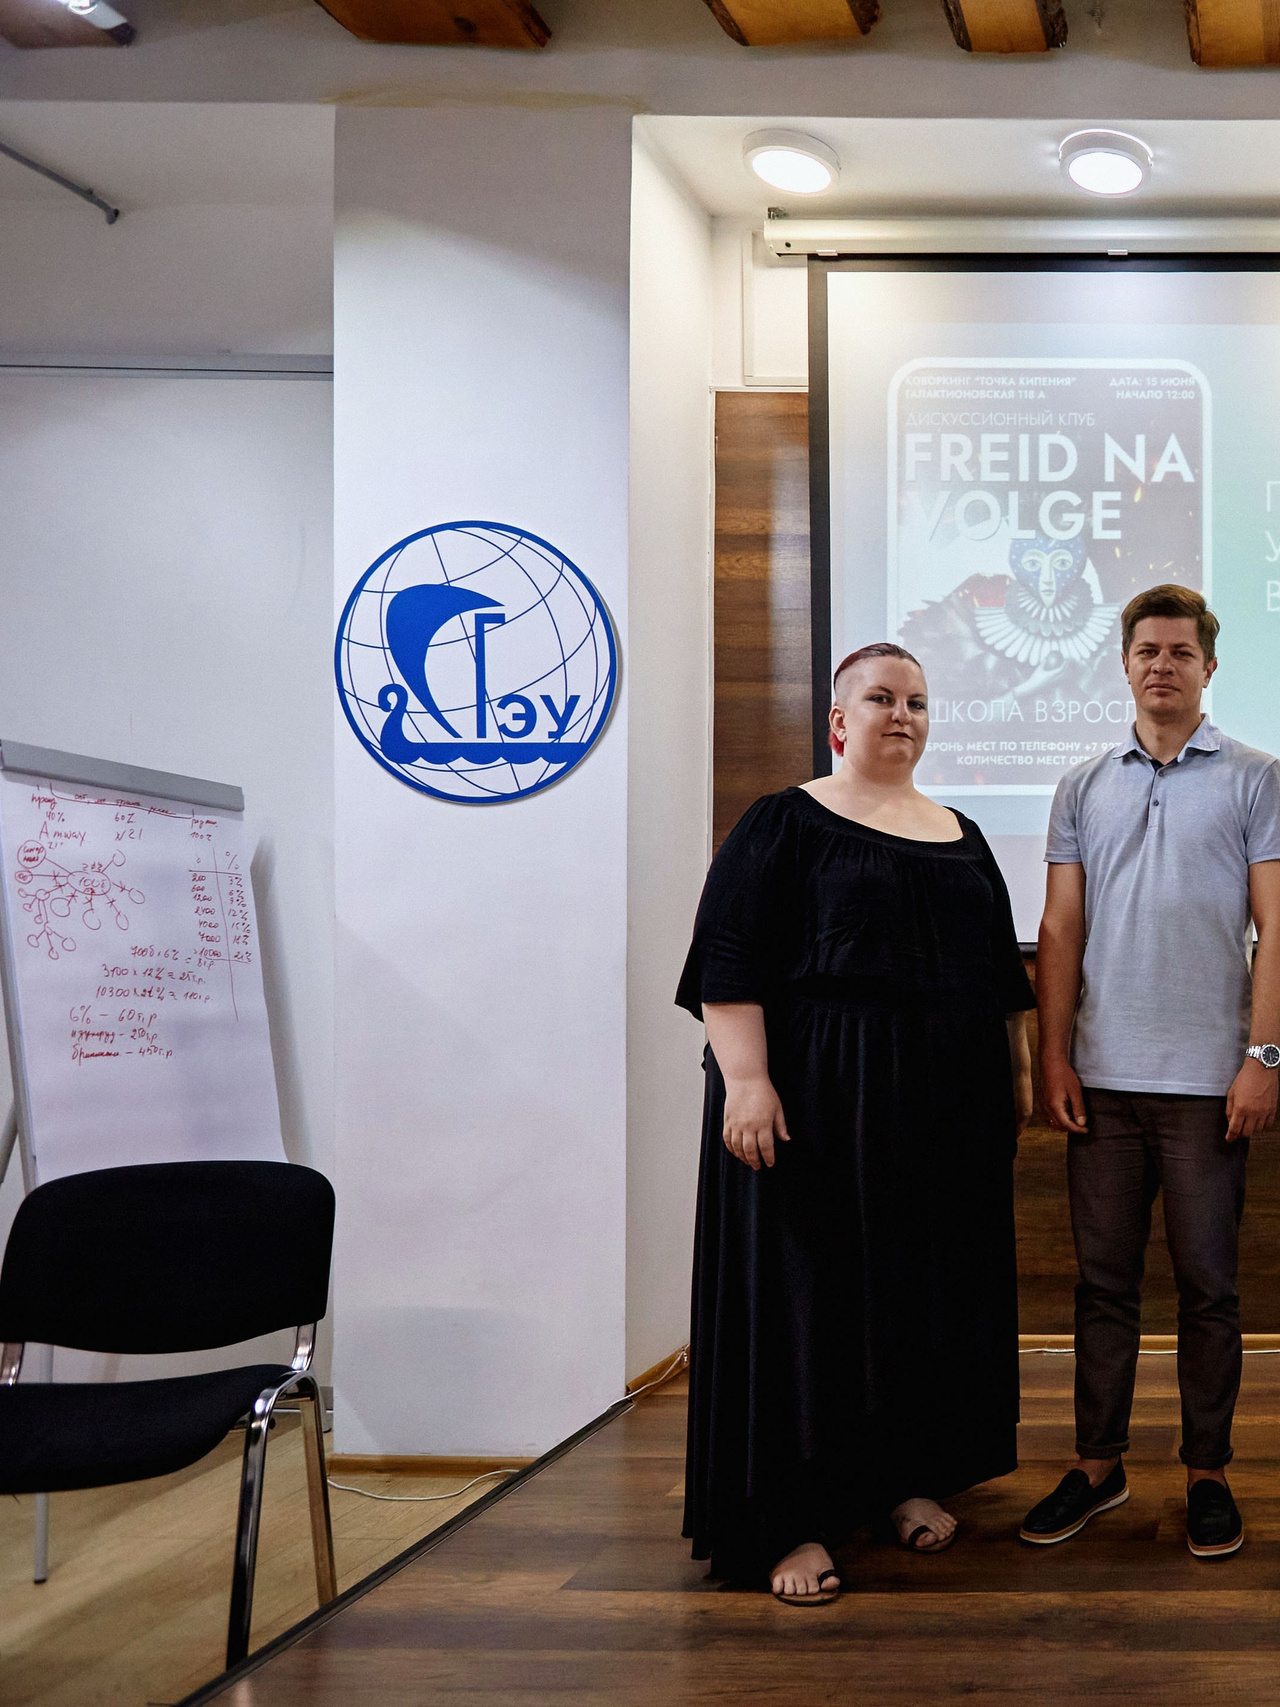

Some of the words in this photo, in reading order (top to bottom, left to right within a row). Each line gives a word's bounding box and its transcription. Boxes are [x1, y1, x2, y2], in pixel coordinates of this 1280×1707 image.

[1109, 377, 1143, 387] ДАТА:
[1160, 377, 1195, 387] ИЮНЯ
[904, 389, 1015, 399] ГАЛАКТИОНОВСКАЯ
[1116, 389, 1163, 400] НАЧАЛО
[1165, 389, 1195, 400] 12:00
[904, 409, 1053, 427] ДИСКУССИОННЫЙ
[1058, 412, 1096, 427] КЛУБ
[904, 432, 1079, 483] FREID
[1103, 431, 1195, 484] NA
[904, 489, 1122, 542] VOLGE
[928, 699, 1025, 723] ШКОЛА
[966, 741, 996, 751] МЕСТ
[999, 741, 1018, 751] ПО
[1020, 741, 1081, 751] ТЕЛЕФОНУ
[956, 755, 1033, 765] КОЛИЧЕСТВО
[1036, 755, 1066, 765] МЕСТ
